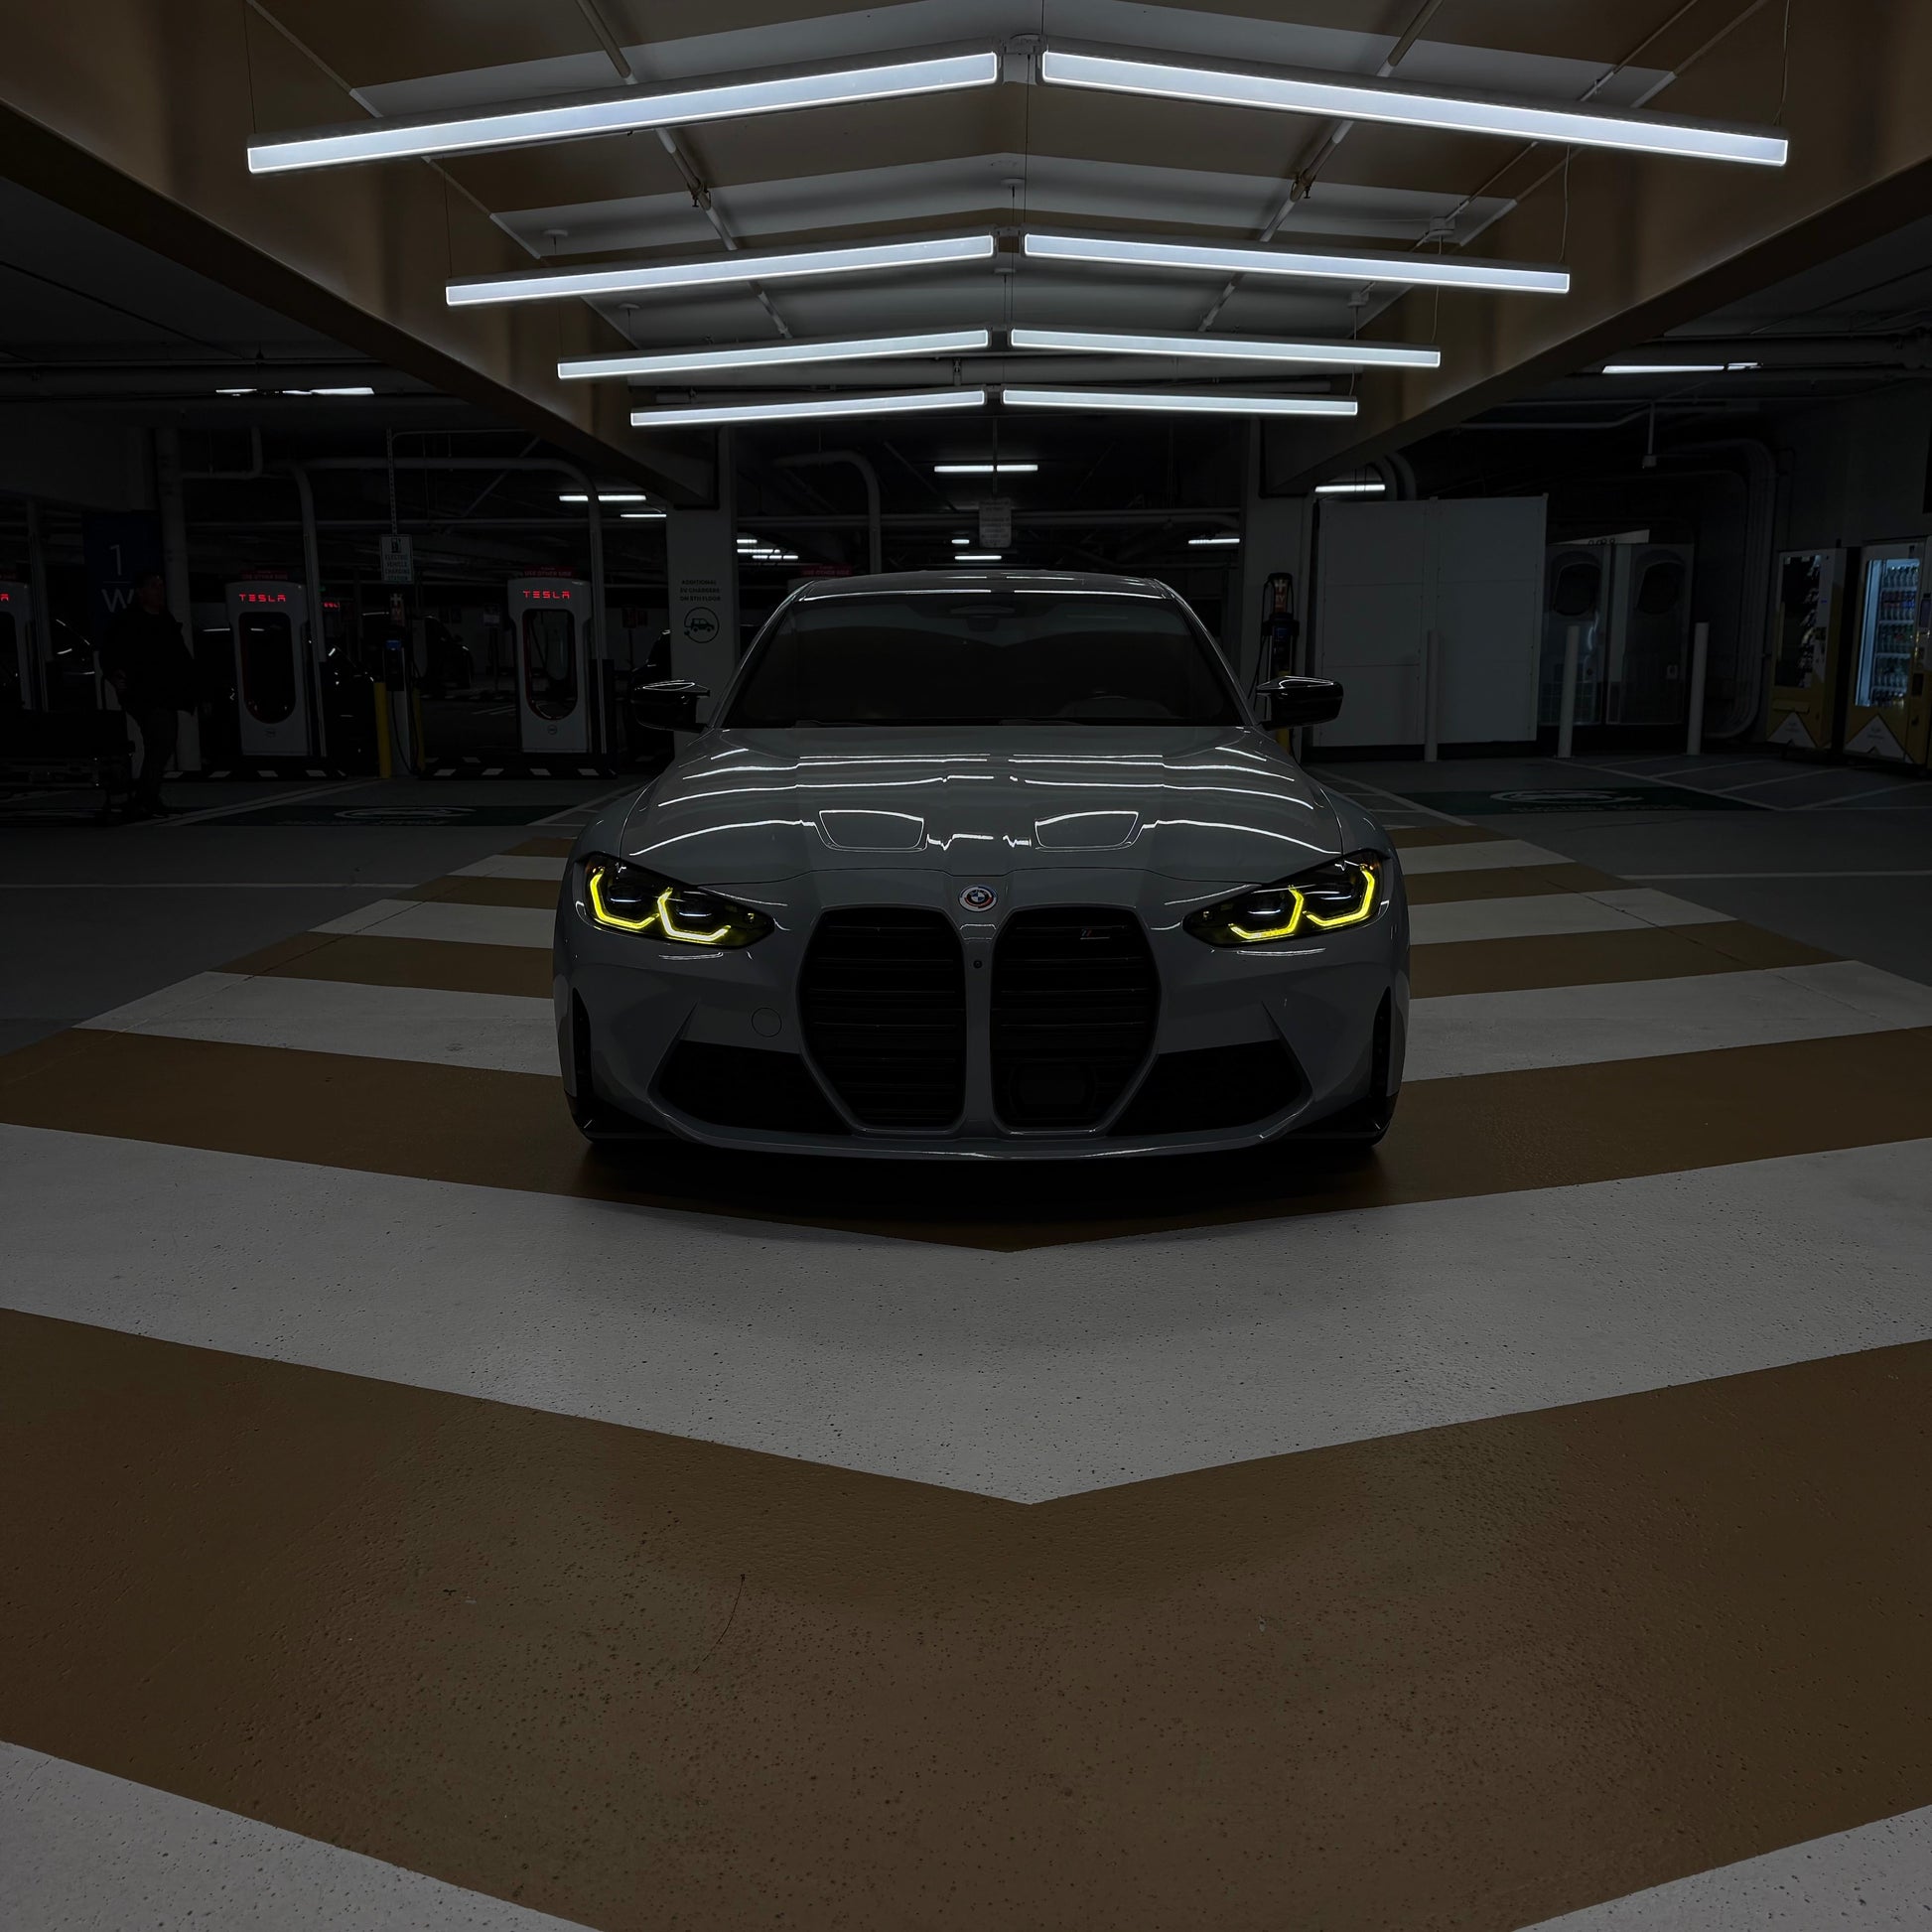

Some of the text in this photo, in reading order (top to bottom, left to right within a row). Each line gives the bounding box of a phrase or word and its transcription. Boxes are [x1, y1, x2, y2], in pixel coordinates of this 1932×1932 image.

[107, 543, 123, 577] 1
[238, 593, 287, 604] TESLA
[522, 589, 572, 600] TESLA
